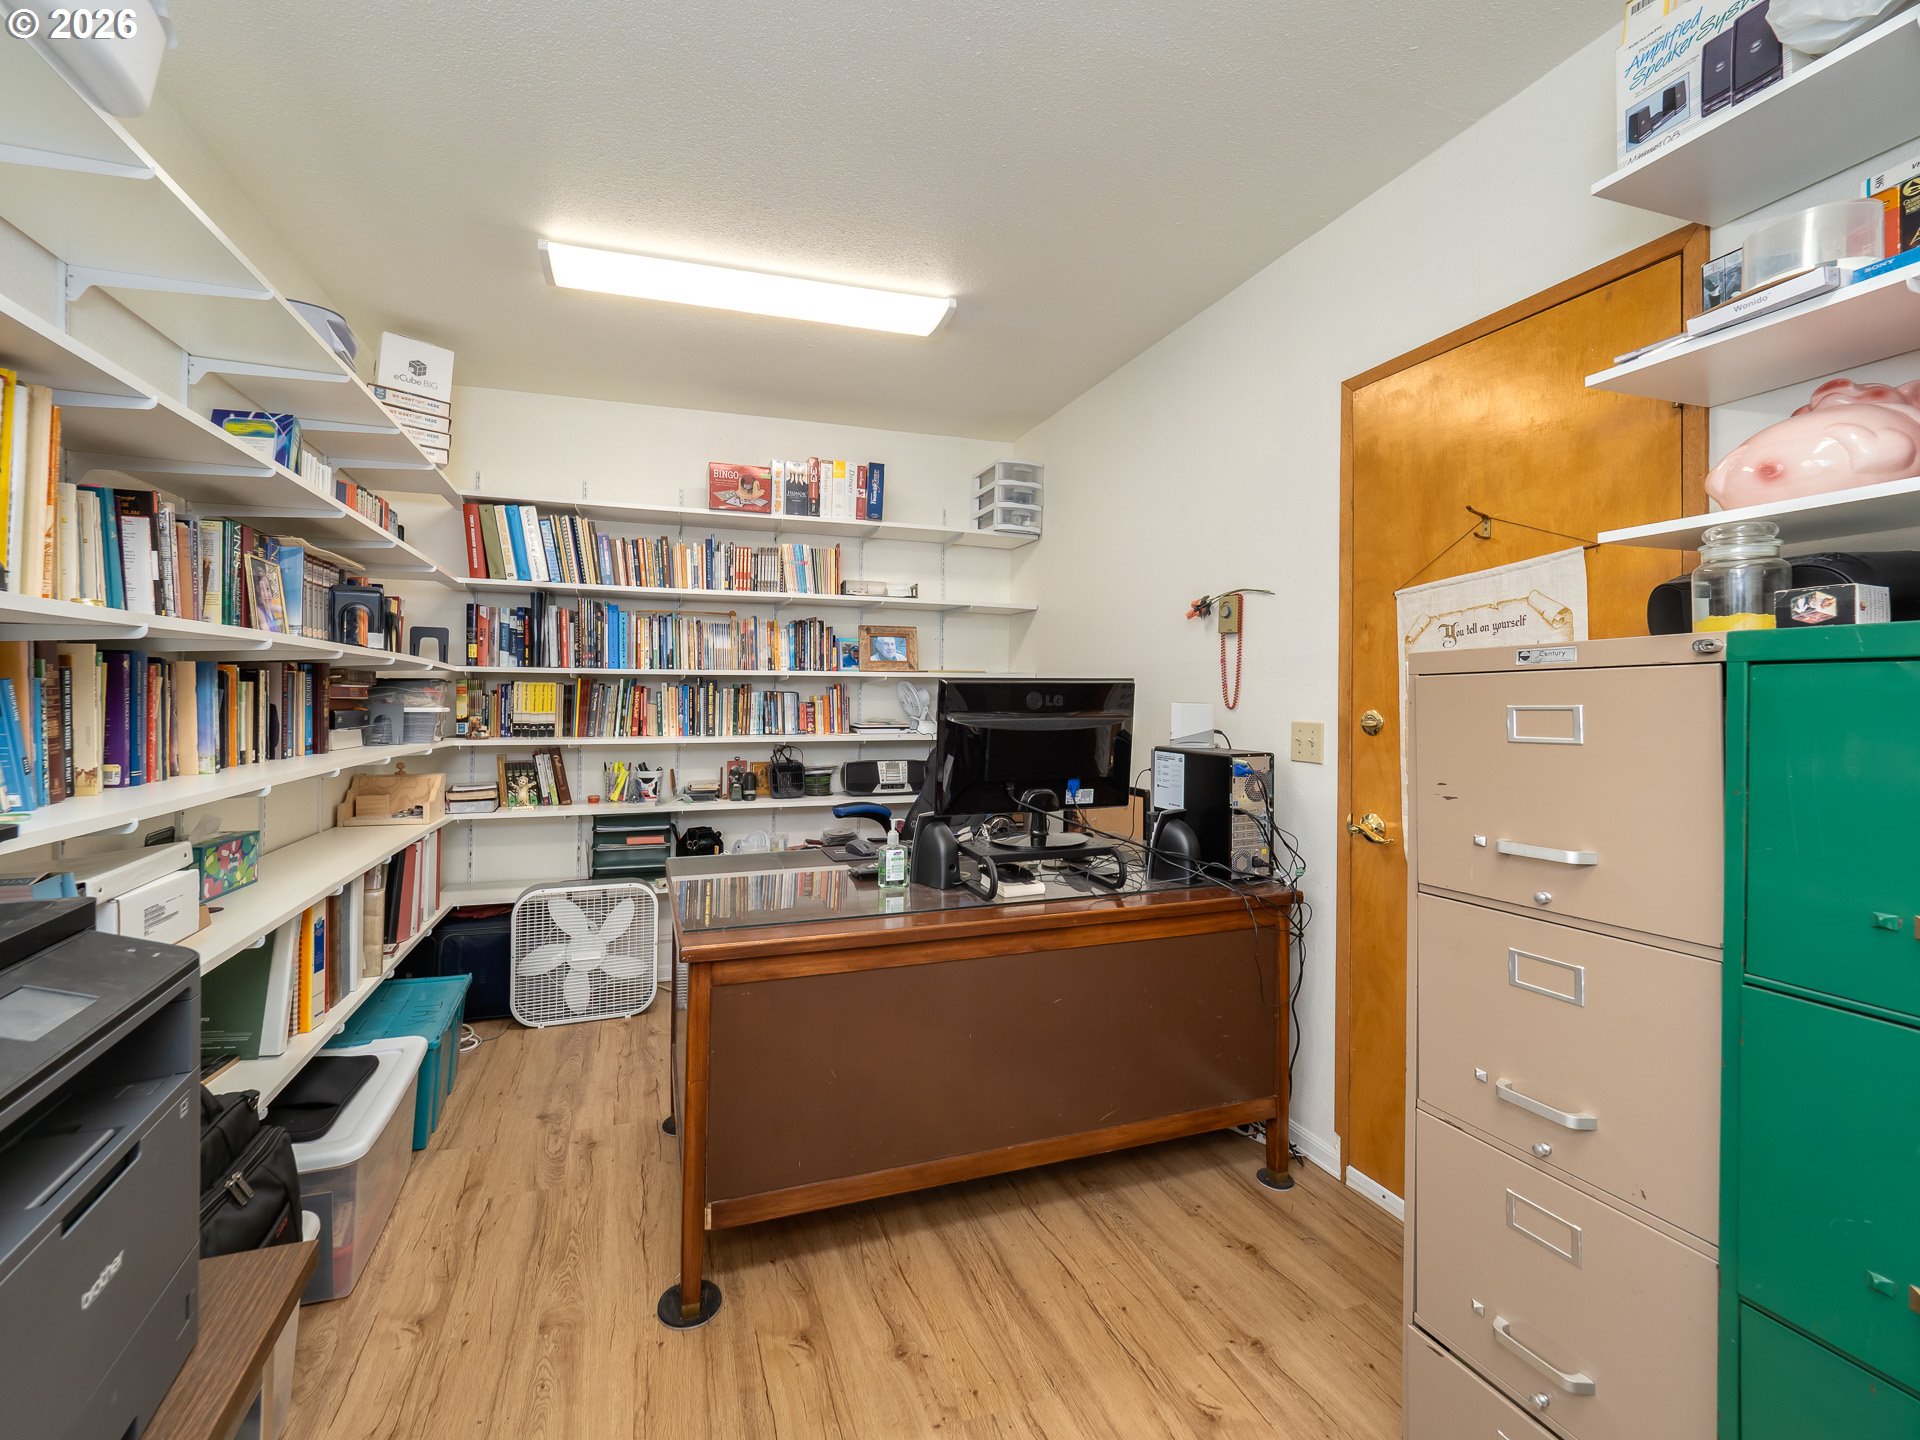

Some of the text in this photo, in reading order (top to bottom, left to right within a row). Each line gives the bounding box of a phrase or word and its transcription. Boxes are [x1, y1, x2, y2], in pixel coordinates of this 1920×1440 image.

[1624, 6, 1703, 78] Amplified
[1629, 30, 1698, 91] Speaker
[1863, 258, 1895, 273] SONY
[393, 373, 439, 390] eCube BIG
[713, 468, 739, 480] BINGO
[233, 524, 242, 568] VINE'S
[1437, 614, 1527, 649] You tell on yourself
[1539, 649, 1566, 658] Century
[1045, 694, 1063, 706] LG
